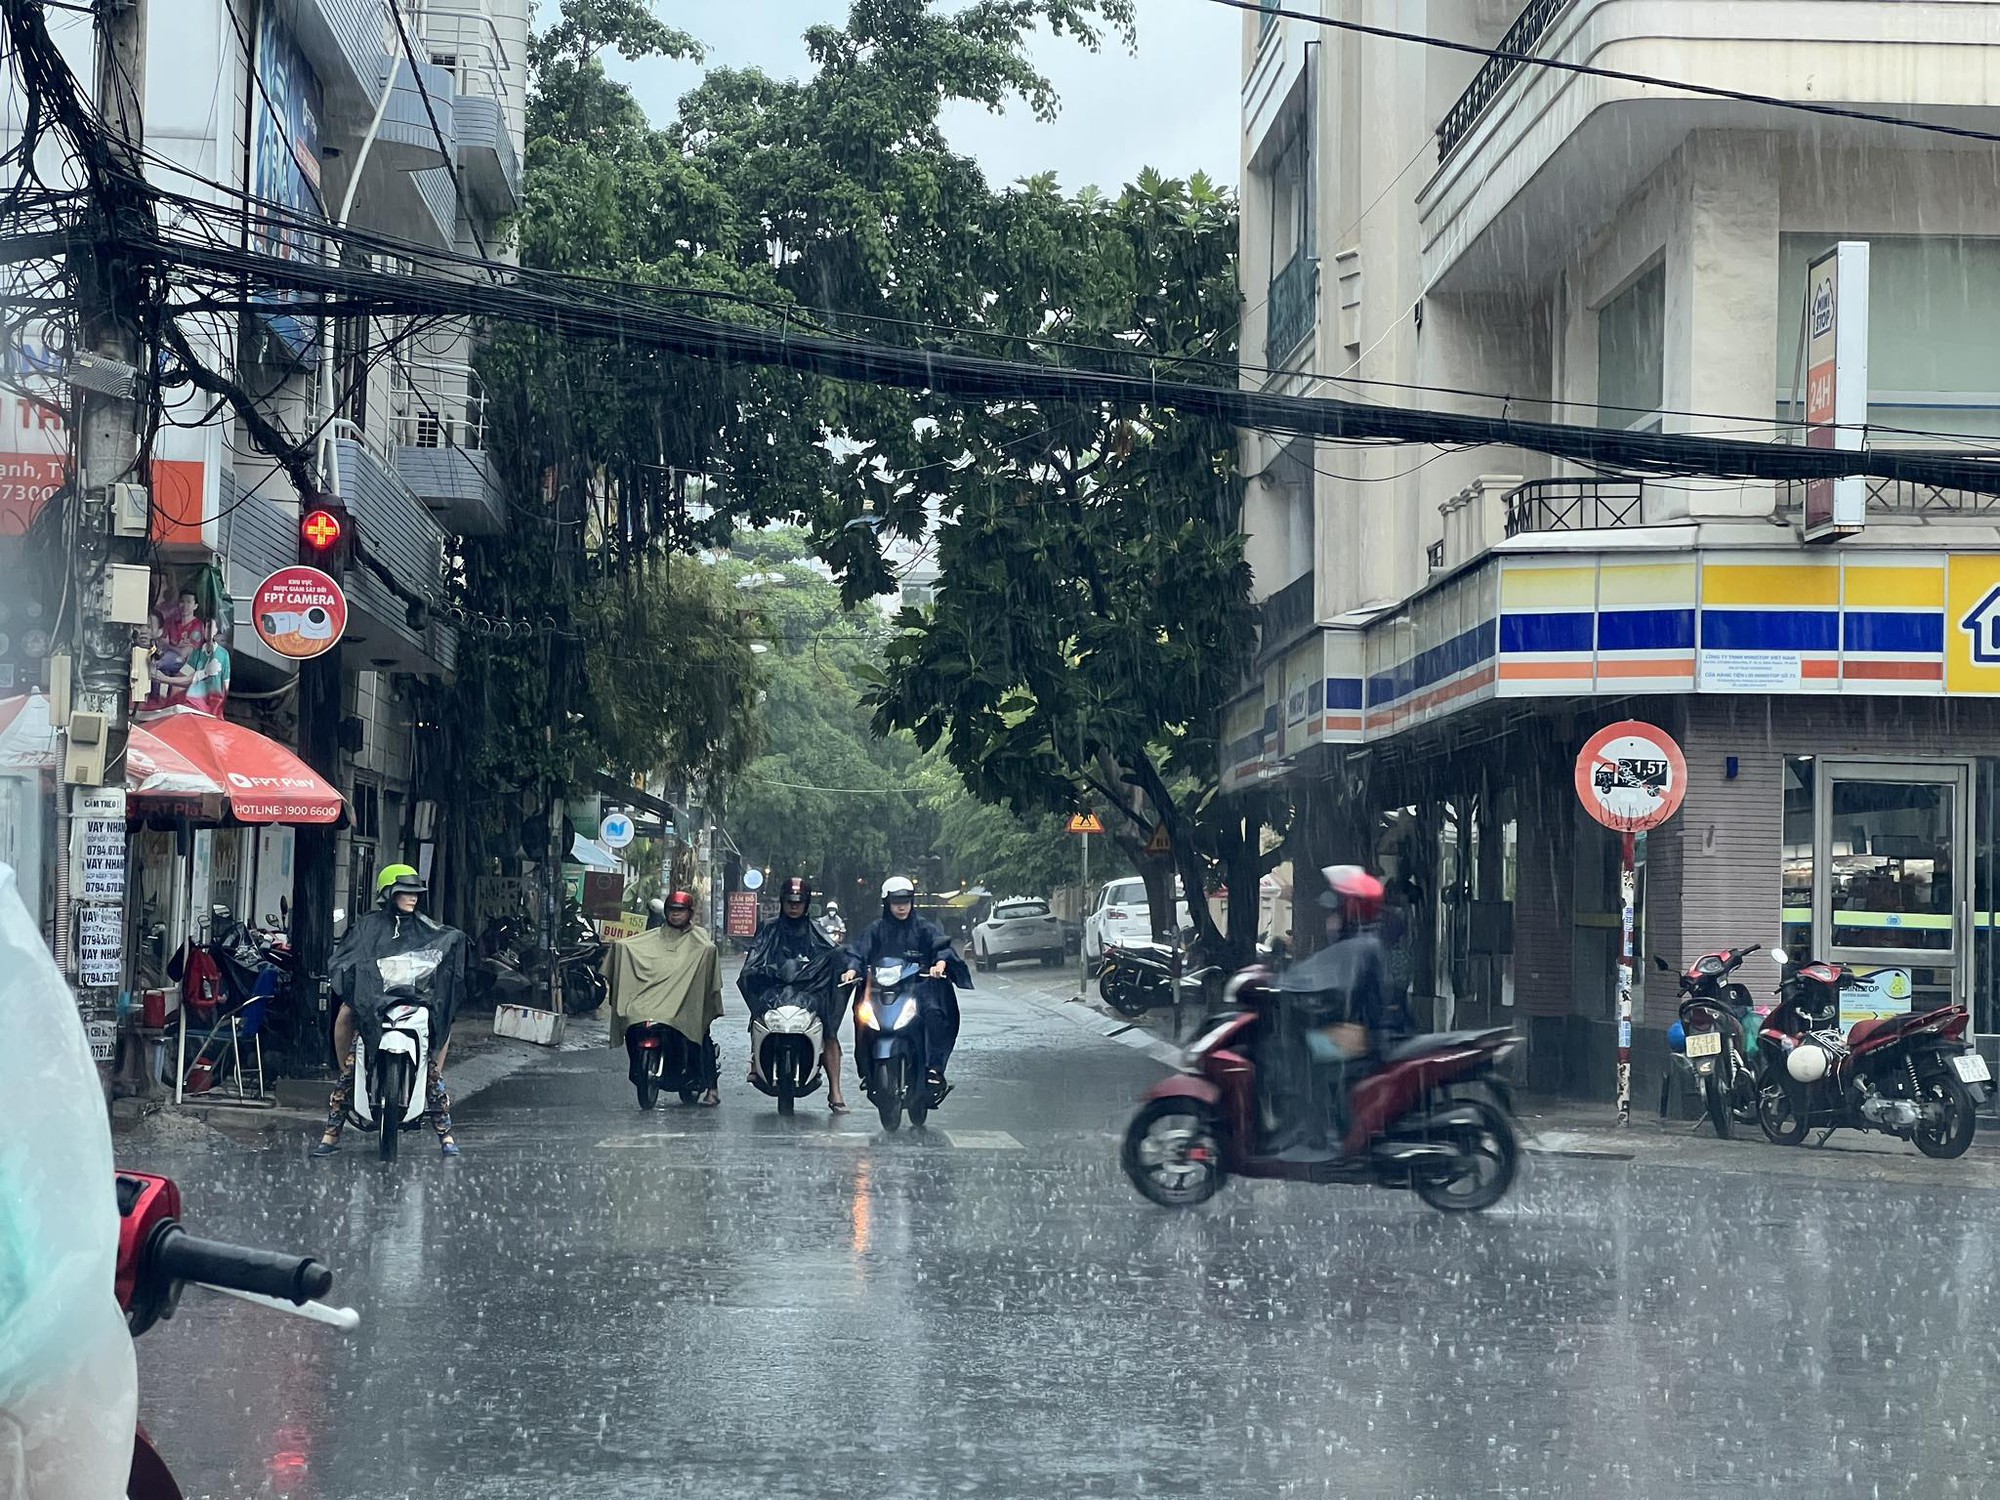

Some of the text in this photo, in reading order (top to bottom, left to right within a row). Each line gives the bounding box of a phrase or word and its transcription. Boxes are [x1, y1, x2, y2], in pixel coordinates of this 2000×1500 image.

[1810, 374, 1831, 414] 24H
[2, 484, 61, 501] 7300
[264, 593, 335, 605] FPT CAMERA
[1634, 761, 1666, 776] 1,5T
[253, 777, 315, 789] FPT Play
[174, 802, 202, 817] Pla
[235, 804, 337, 817] HOTLINE: 1900 6600
[87, 821, 104, 833] VAY
[86, 858, 103, 870] VAY
[81, 949, 98, 960] VAY
